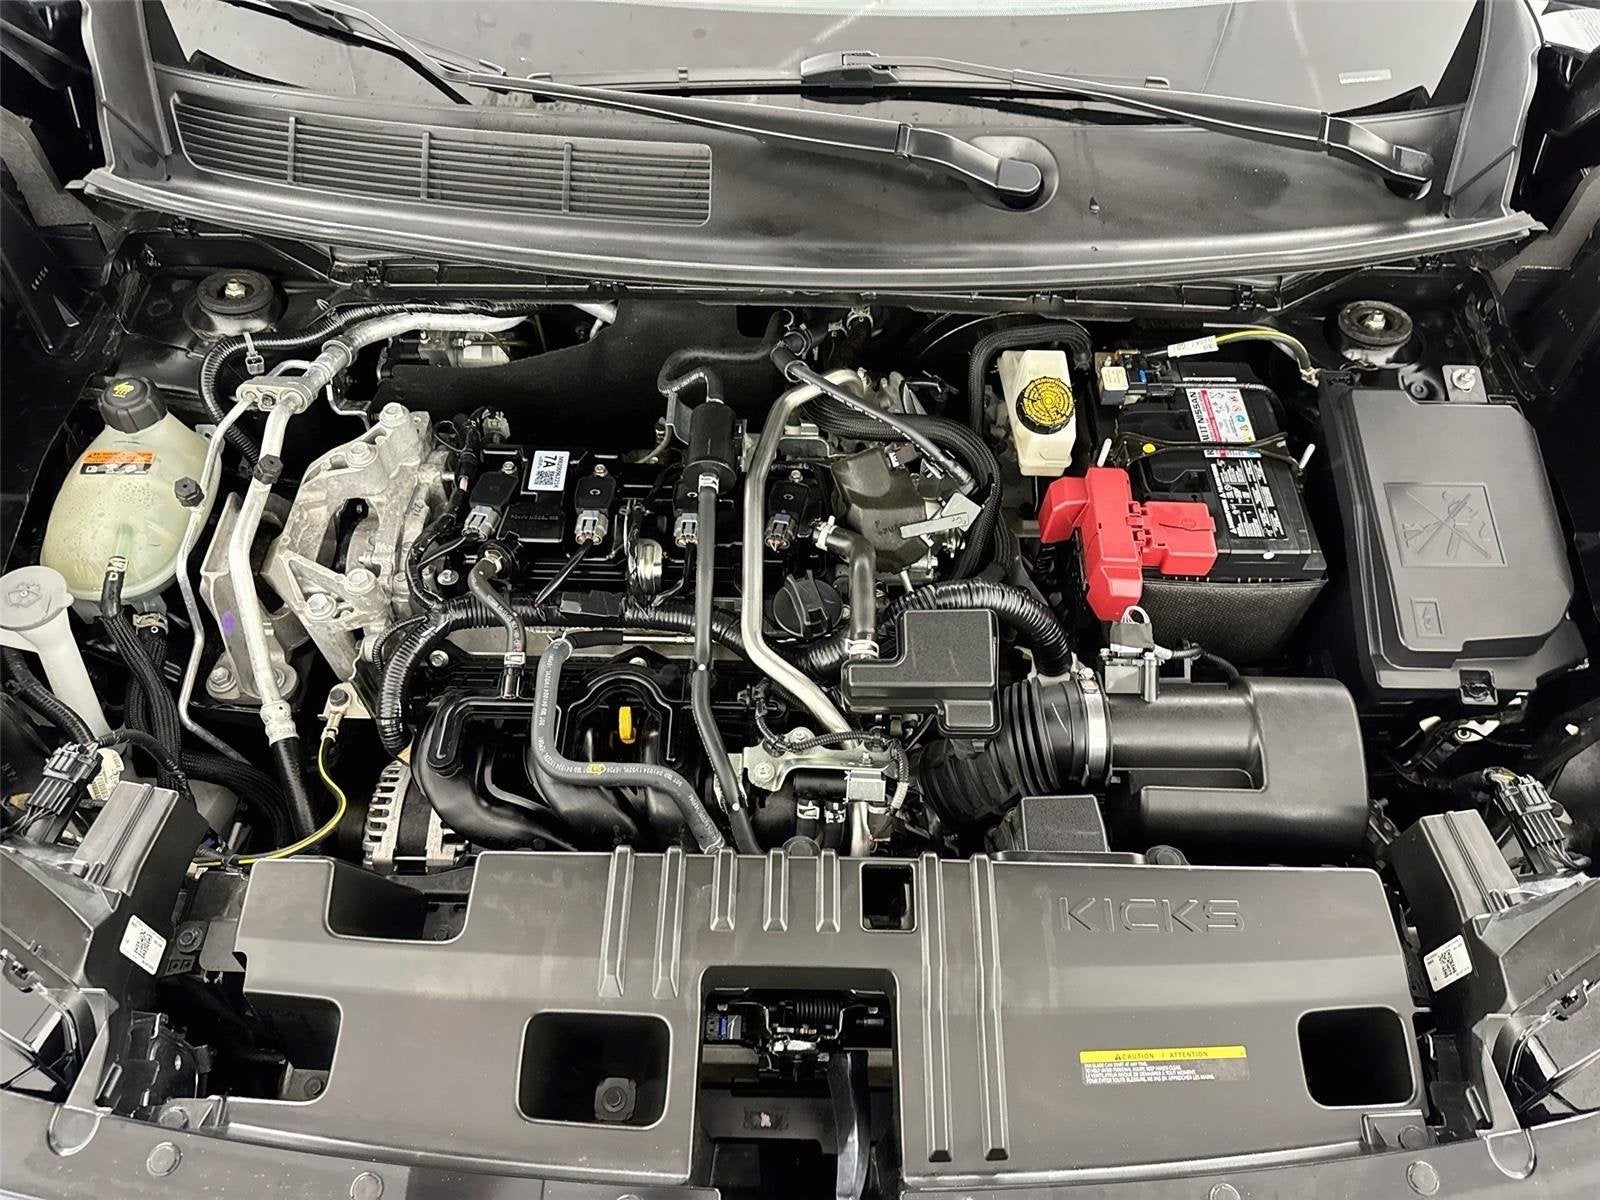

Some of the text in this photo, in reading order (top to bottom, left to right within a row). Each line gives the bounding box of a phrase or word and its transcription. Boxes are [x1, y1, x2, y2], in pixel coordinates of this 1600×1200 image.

[1189, 391, 1204, 424] NISSAN
[542, 455, 558, 468] 7A
[1059, 897, 1245, 933] KICKS
